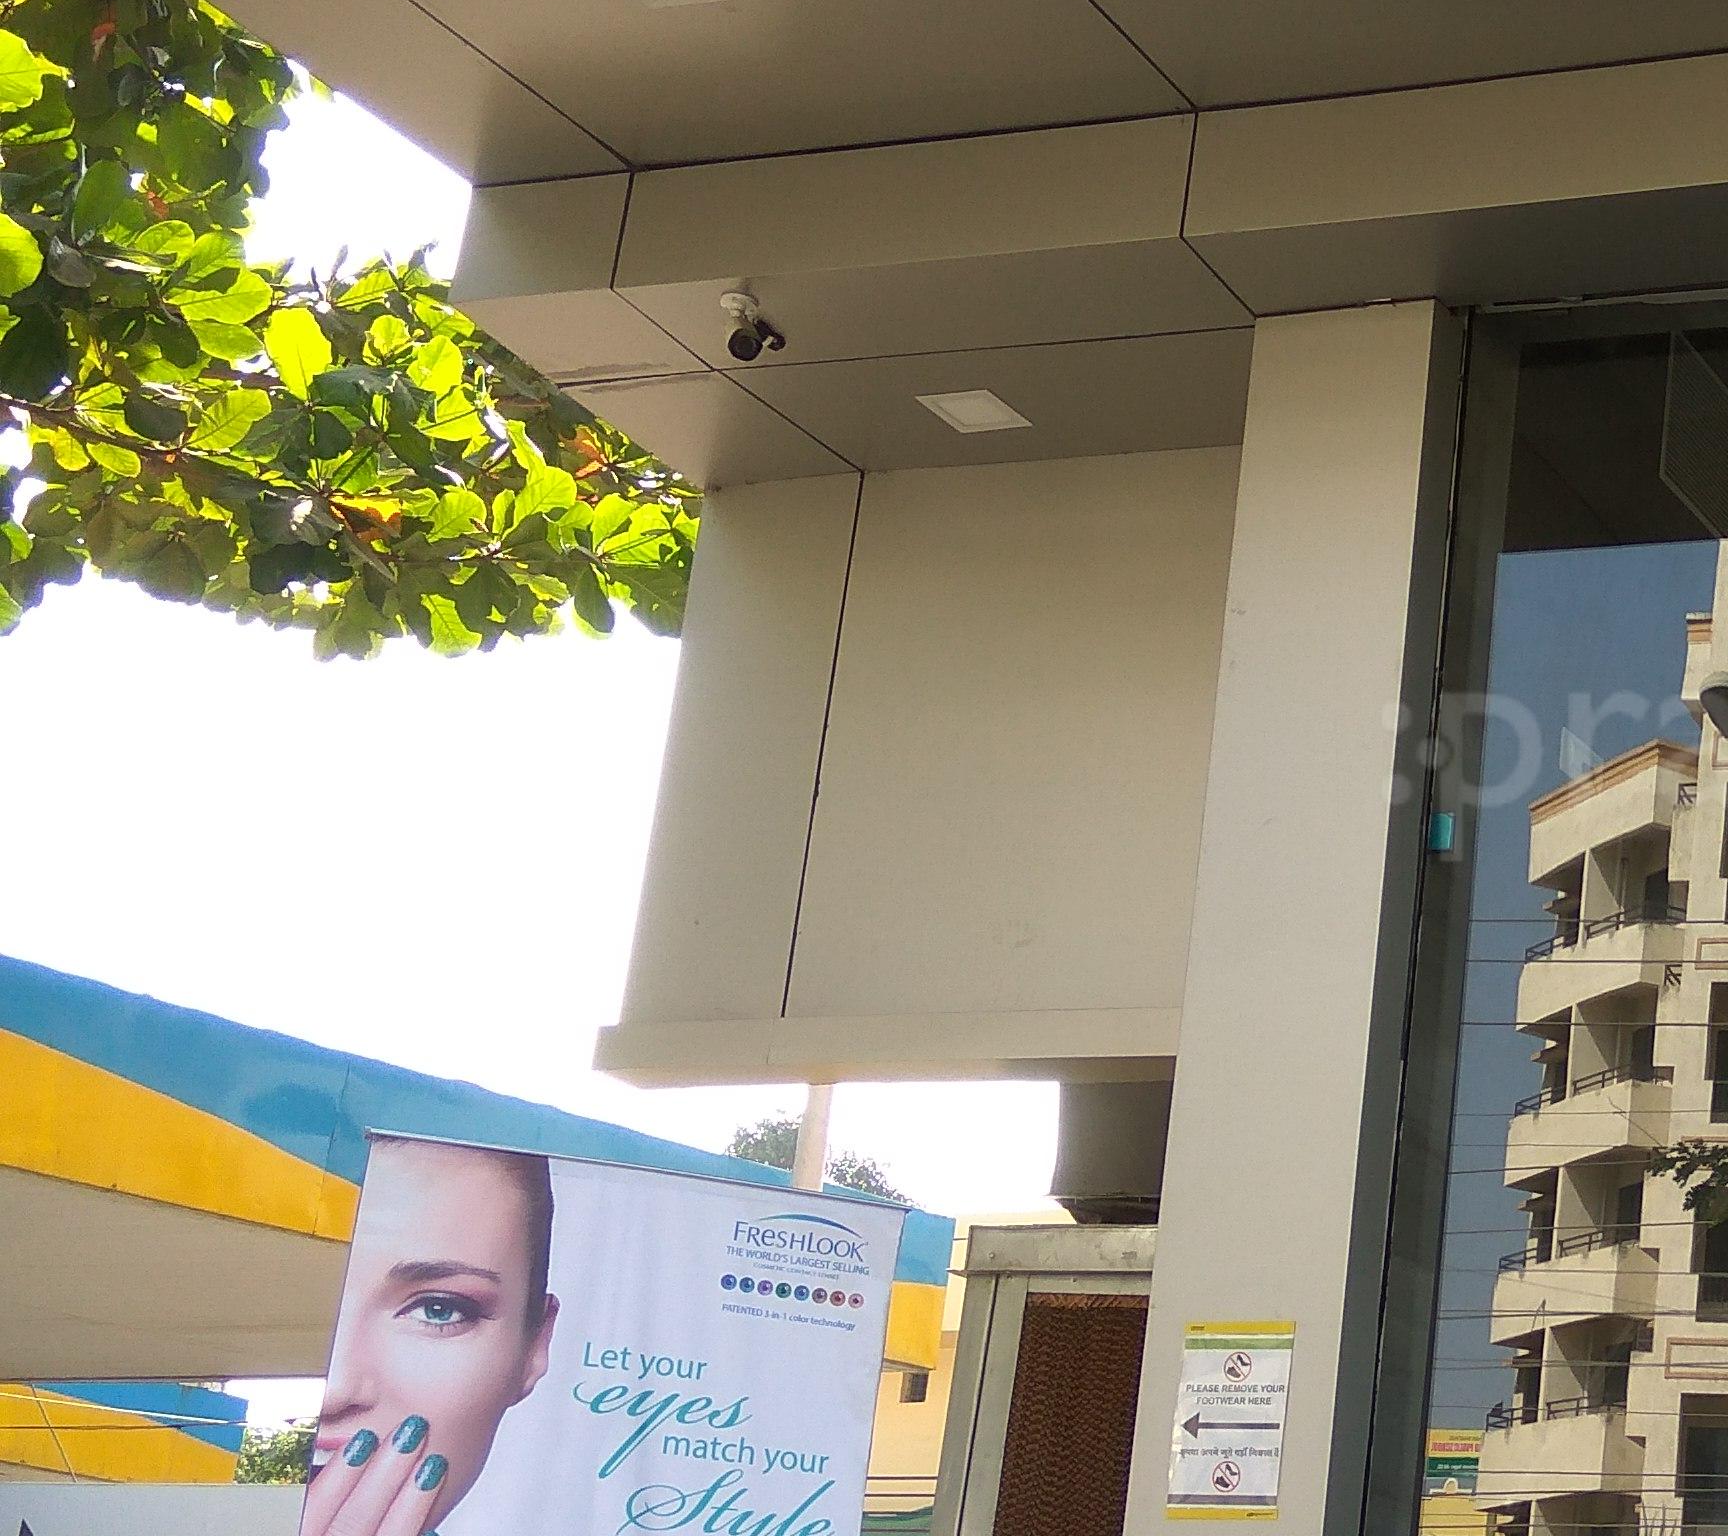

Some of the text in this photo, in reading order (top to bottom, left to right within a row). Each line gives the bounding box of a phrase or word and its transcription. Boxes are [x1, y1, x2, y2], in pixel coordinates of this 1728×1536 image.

[726, 1245, 870, 1276] THE WORLD'S LARGEST SELLING
[722, 1303, 763, 1317] PATENTED
[788, 1313, 810, 1324] color
[810, 1316, 856, 1332] technology
[582, 1341, 708, 1381] Let your
[1185, 1384, 1285, 1393] PLEASE REMOVE YOUR
[1196, 1396, 1272, 1405] FOOTWEAR HERE
[572, 1376, 754, 1481] eyes
[661, 1431, 830, 1477] match your
